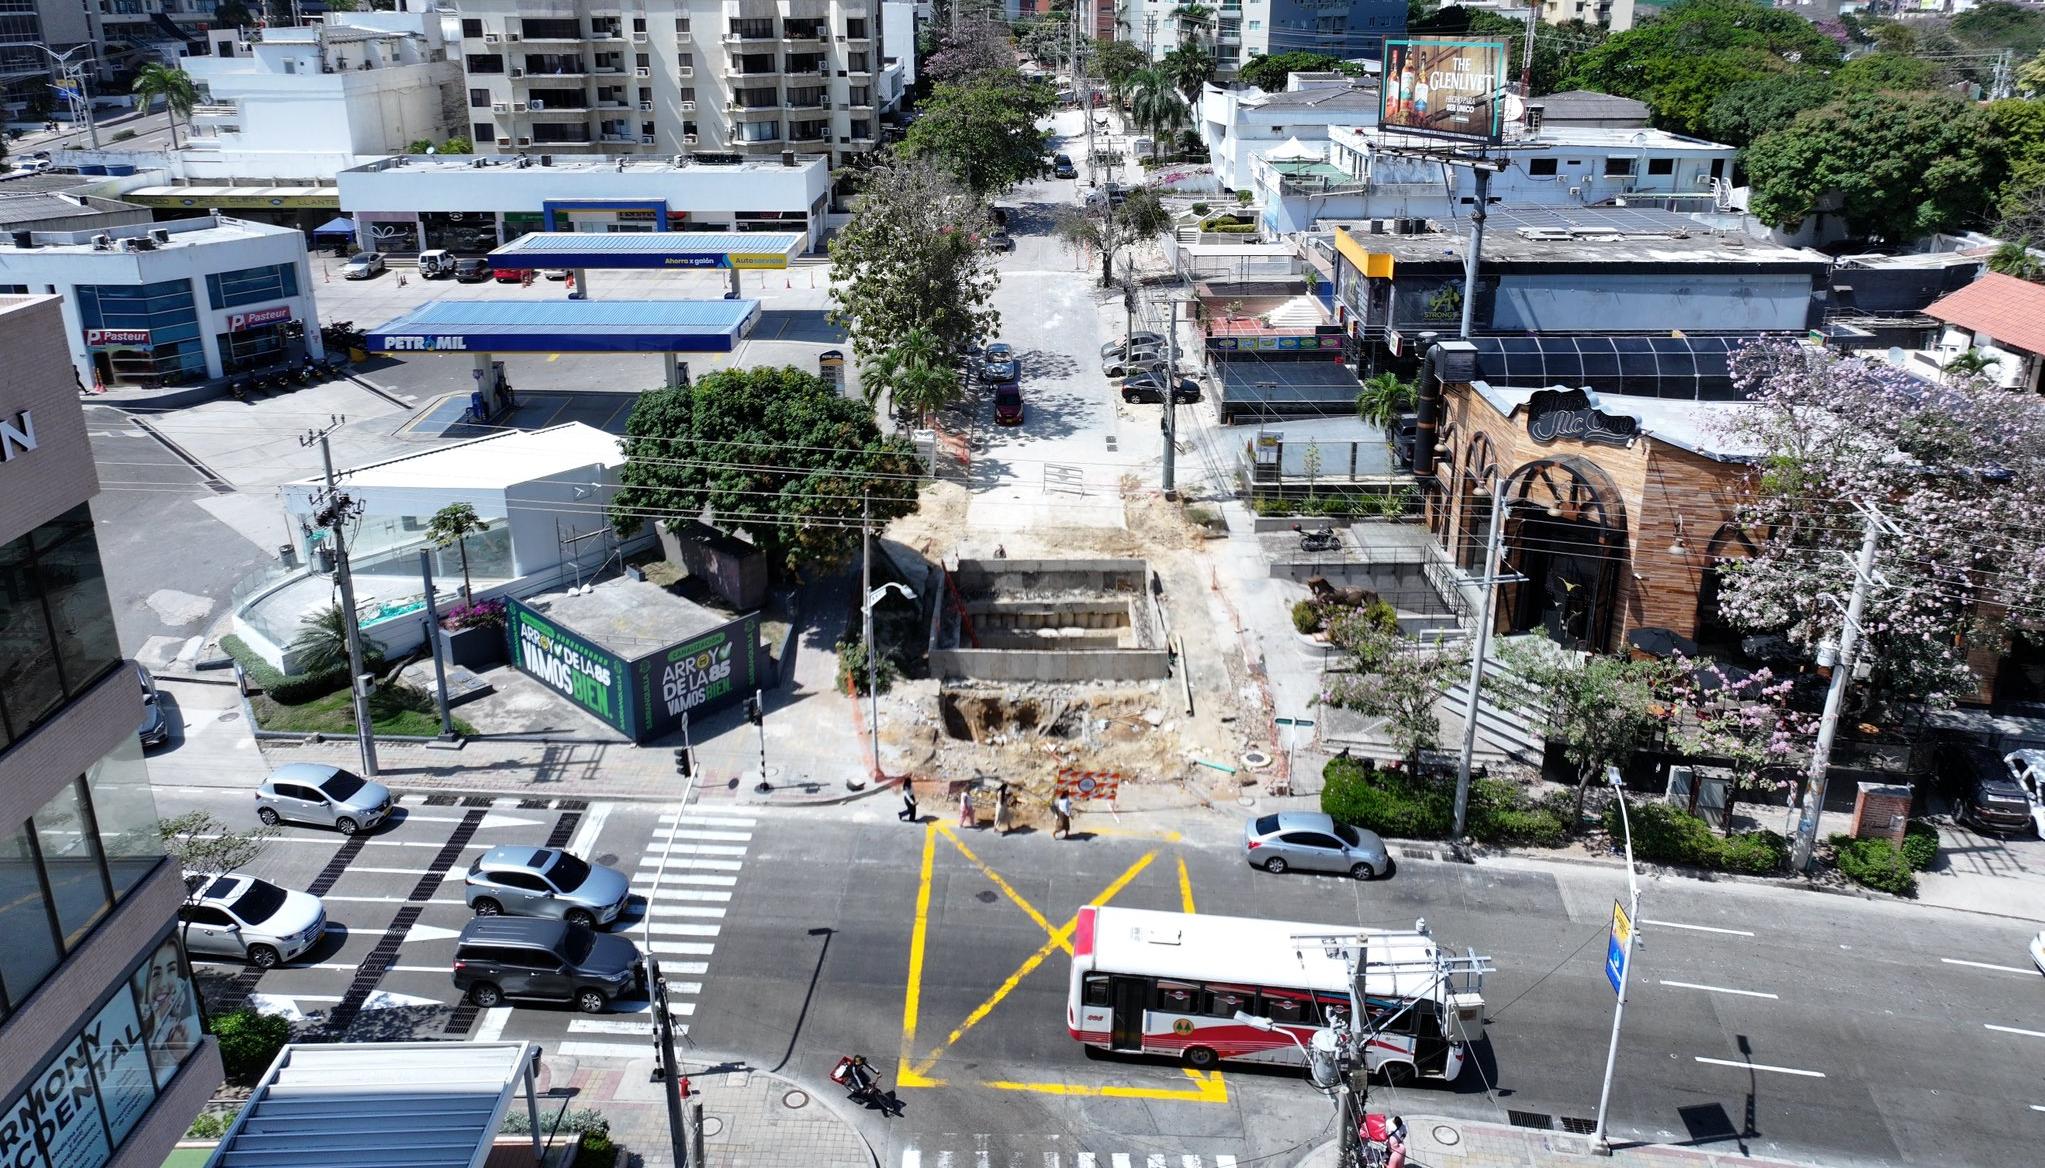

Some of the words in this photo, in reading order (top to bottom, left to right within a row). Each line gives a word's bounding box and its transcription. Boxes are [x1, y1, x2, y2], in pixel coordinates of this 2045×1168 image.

[1453, 58, 1473, 71] THE
[1430, 71, 1494, 94] GLENLIVET
[664, 257, 689, 265] Ahorra
[249, 310, 288, 323] Pasteur
[103, 331, 147, 342] Pasteur
[522, 639, 573, 695] VAMOS
[563, 646, 580, 670] DE
[580, 656, 595, 679] LA
[593, 664, 611, 687] 85
[663, 677, 686, 701] DE
[689, 670, 708, 691] LA
[708, 659, 731, 682] 85
[667, 687, 706, 717] VAMOS
